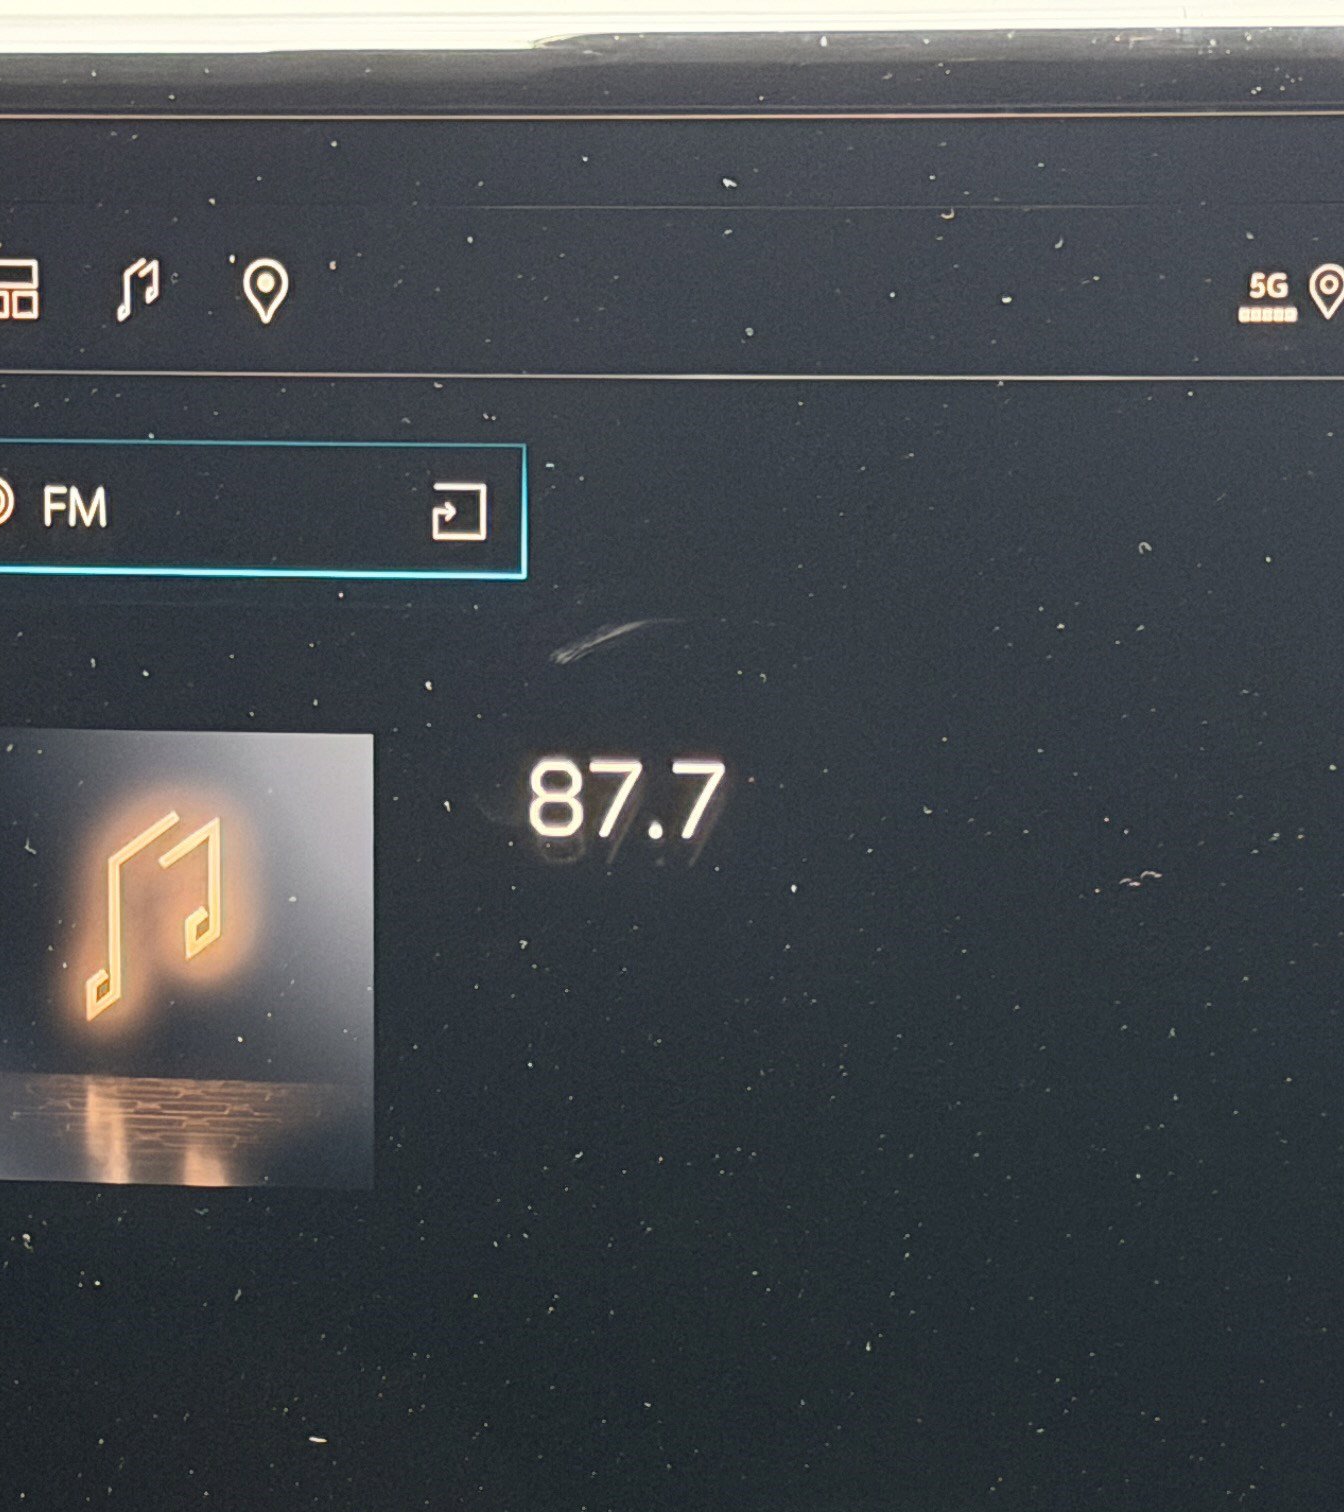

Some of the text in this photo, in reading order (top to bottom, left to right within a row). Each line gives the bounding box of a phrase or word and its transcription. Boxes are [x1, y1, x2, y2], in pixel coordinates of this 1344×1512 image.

[1248, 270, 1291, 300] 5G
[42, 483, 109, 529] FM
[527, 755, 727, 841] 87.7
